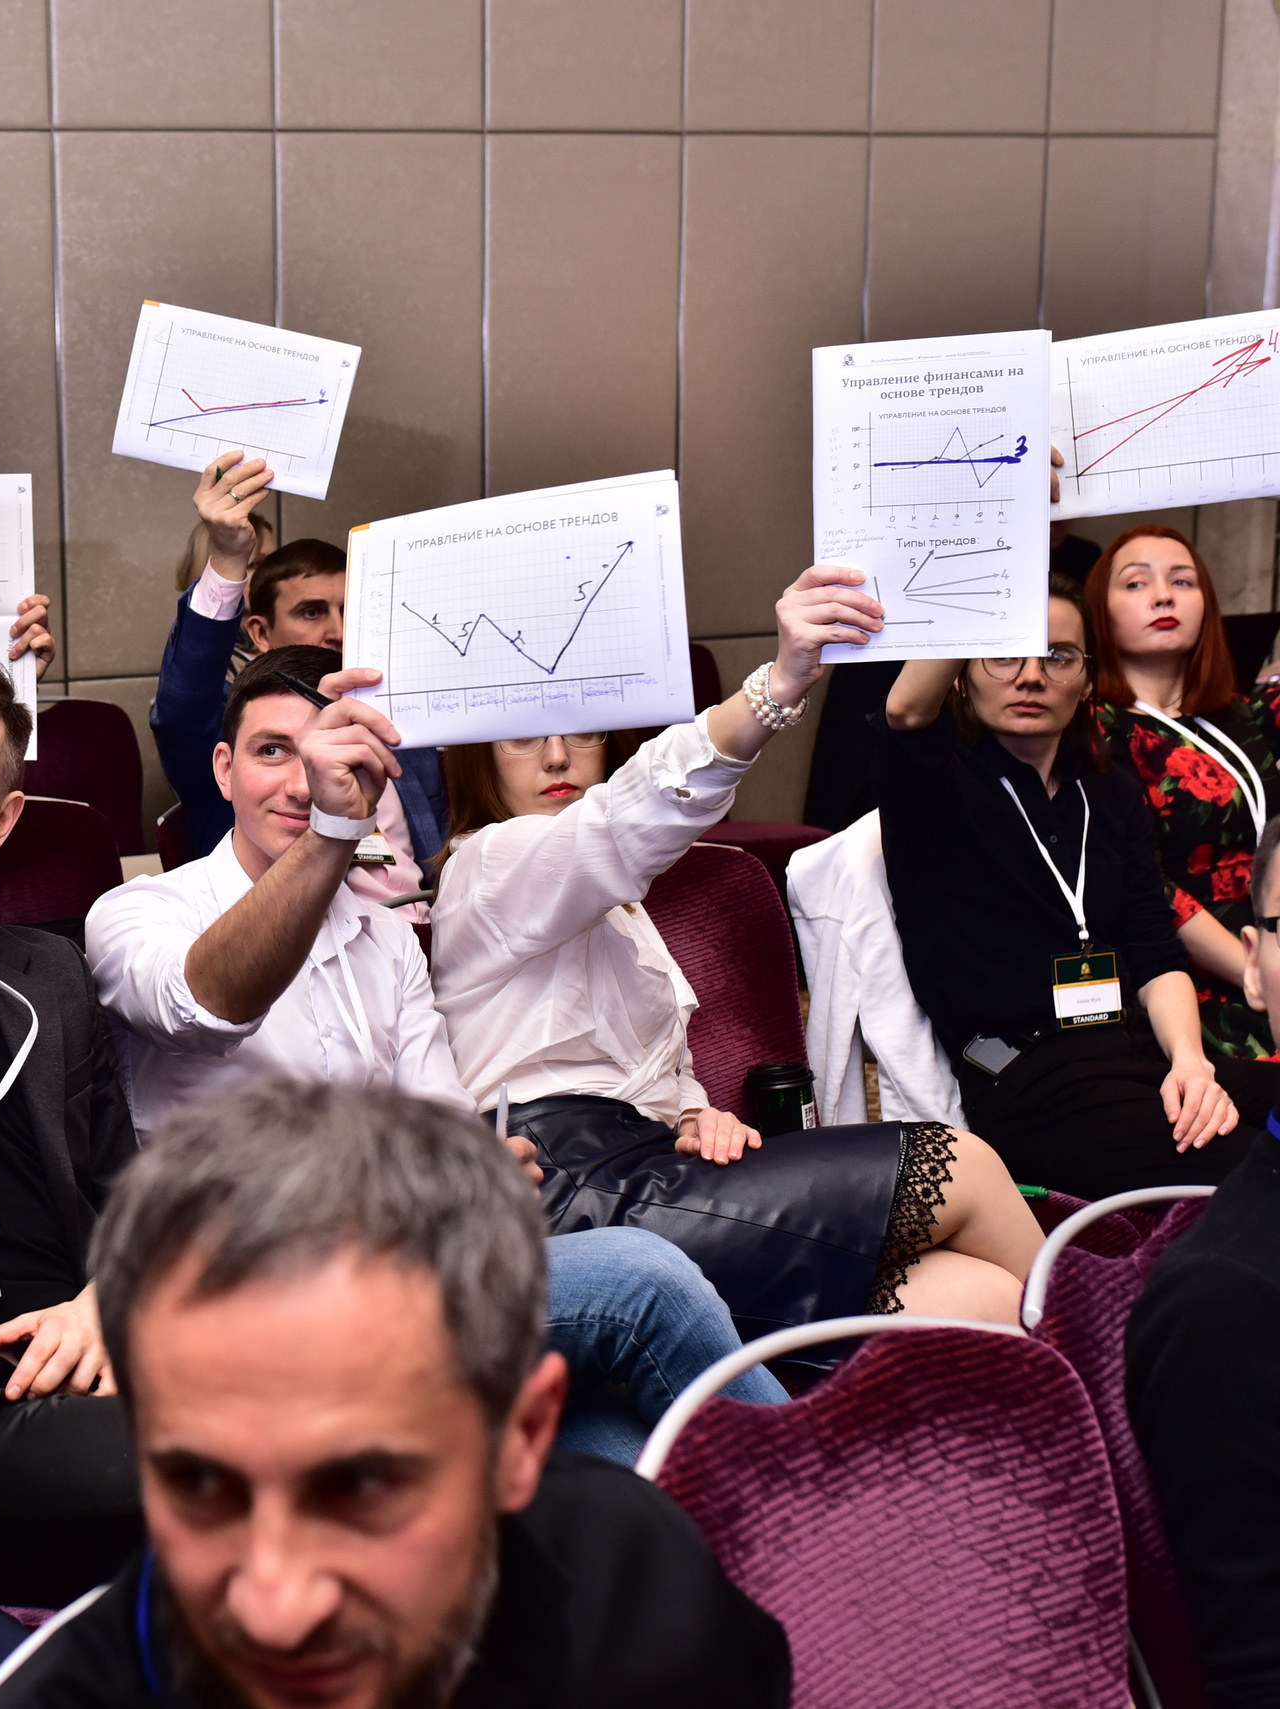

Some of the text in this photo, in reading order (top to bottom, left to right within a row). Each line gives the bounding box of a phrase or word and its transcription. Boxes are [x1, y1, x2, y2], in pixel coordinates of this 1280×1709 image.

[181, 327, 320, 363] УПРАВЛЕНИЕ НА ОСНОВЕ ТРЕНДОВ
[1080, 334, 1262, 366] УПРАВЛЕНИЕ НА ОСНОВЕ ТРЕНДОВ
[841, 367, 1024, 389] Управление финансами на
[880, 385, 984, 400] основе трендов
[878, 410, 928, 420] УПРАВЛЕНИЕ
[940, 408, 970, 416] ОСНОВЕ
[407, 511, 619, 552] УПРАВЛЕНИЕ НА ОСНОВЕ ТРЕНДОВ
[896, 536, 980, 549] Типы трендов:
[997, 536, 1005, 547] 6
[909, 558, 916, 569] 5
[1000, 569, 1010, 580] 4
[574, 580, 593, 602] 5
[1004, 588, 1012, 599] 3
[431, 613, 441, 625] 1
[999, 611, 1007, 620] 2
[458, 622, 473, 638] 5
[1073, 1013, 1109, 1024] STANDARD
